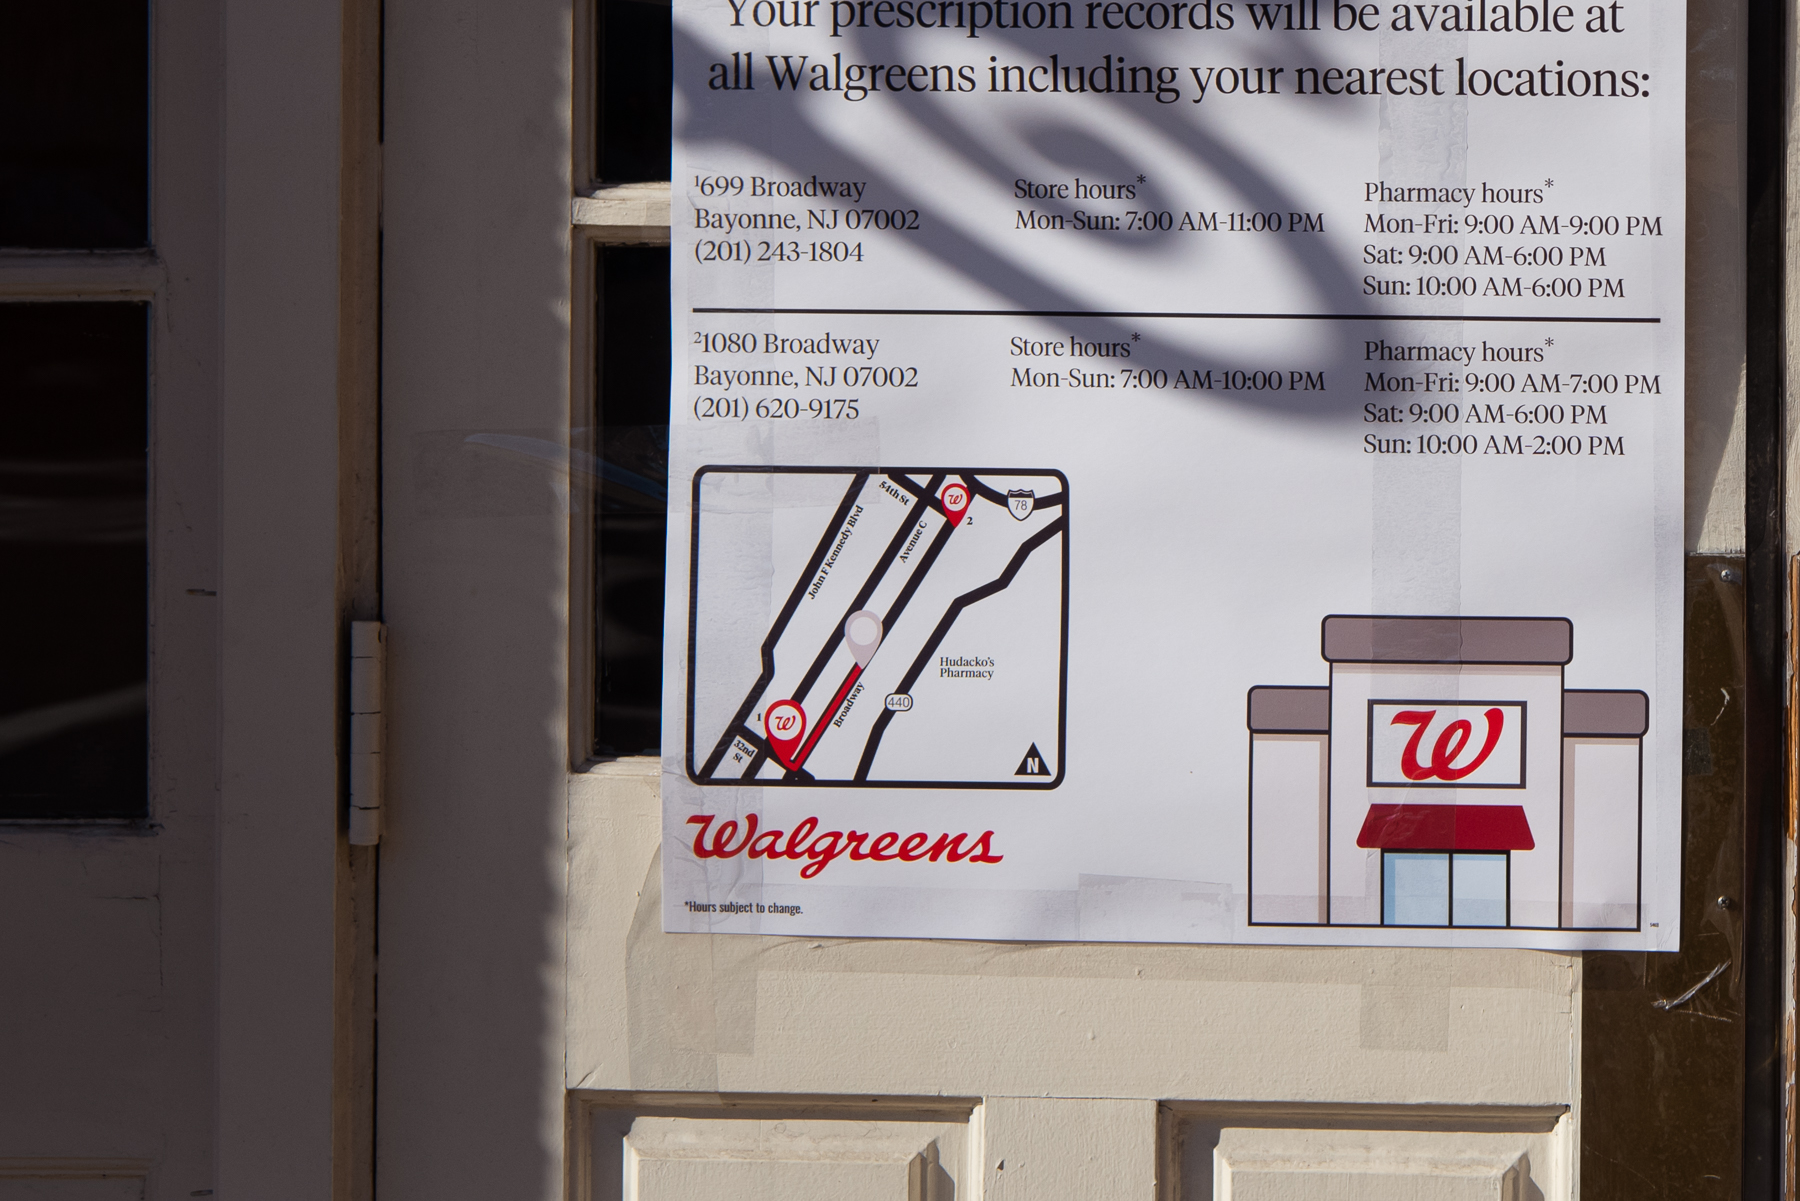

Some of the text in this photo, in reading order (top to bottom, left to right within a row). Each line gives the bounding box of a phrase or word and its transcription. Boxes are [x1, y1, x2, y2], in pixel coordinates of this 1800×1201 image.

[1586, 0, 1624, 33] at
[709, 52, 1649, 104] all Walgreens including your nearest locations:
[751, 175, 866, 203] Broadway
[1015, 179, 1068, 199] Store
[1365, 181, 1475, 208] Pharmacy
[695, 208, 920, 234] Bayonne, NJ 07002
[1015, 210, 1325, 232] Mon-Sun: 7:00 AM-11:00 PM
[1364, 214, 1662, 236] Mon-Fri: 9:00 AM-9:00 PM
[695, 239, 864, 264] (201) 243-1804
[1364, 245, 1606, 266] Sat: 9:00 AM-6:00 PM
[1363, 276, 1625, 297] Sun: 10:00 AM-6:00 PM
[763, 332, 879, 360] Broadway
[695, 365, 918, 391] Bayonne, NJ 07002
[694, 396, 859, 421] (201) 620-9175
[879, 481, 910, 506] 54th St
[1014, 500, 1028, 510] 78
[808, 575, 825, 599] John
[825, 527, 853, 569] Kennedy
[848, 505, 864, 528] Blvd
[899, 529, 923, 563] Avenue
[939, 656, 995, 667] Hudacko's
[940, 667, 994, 680] Pharmacy
[833, 682, 865, 728] Broadway
[887, 697, 910, 707] 440
[733, 753, 743, 763] St
[734, 740, 754, 757] 32nd
[686, 813, 1004, 879] Walgreens
[719, 902, 753, 914] subject
[756, 903, 765, 913] to
[768, 903, 803, 916] change.
